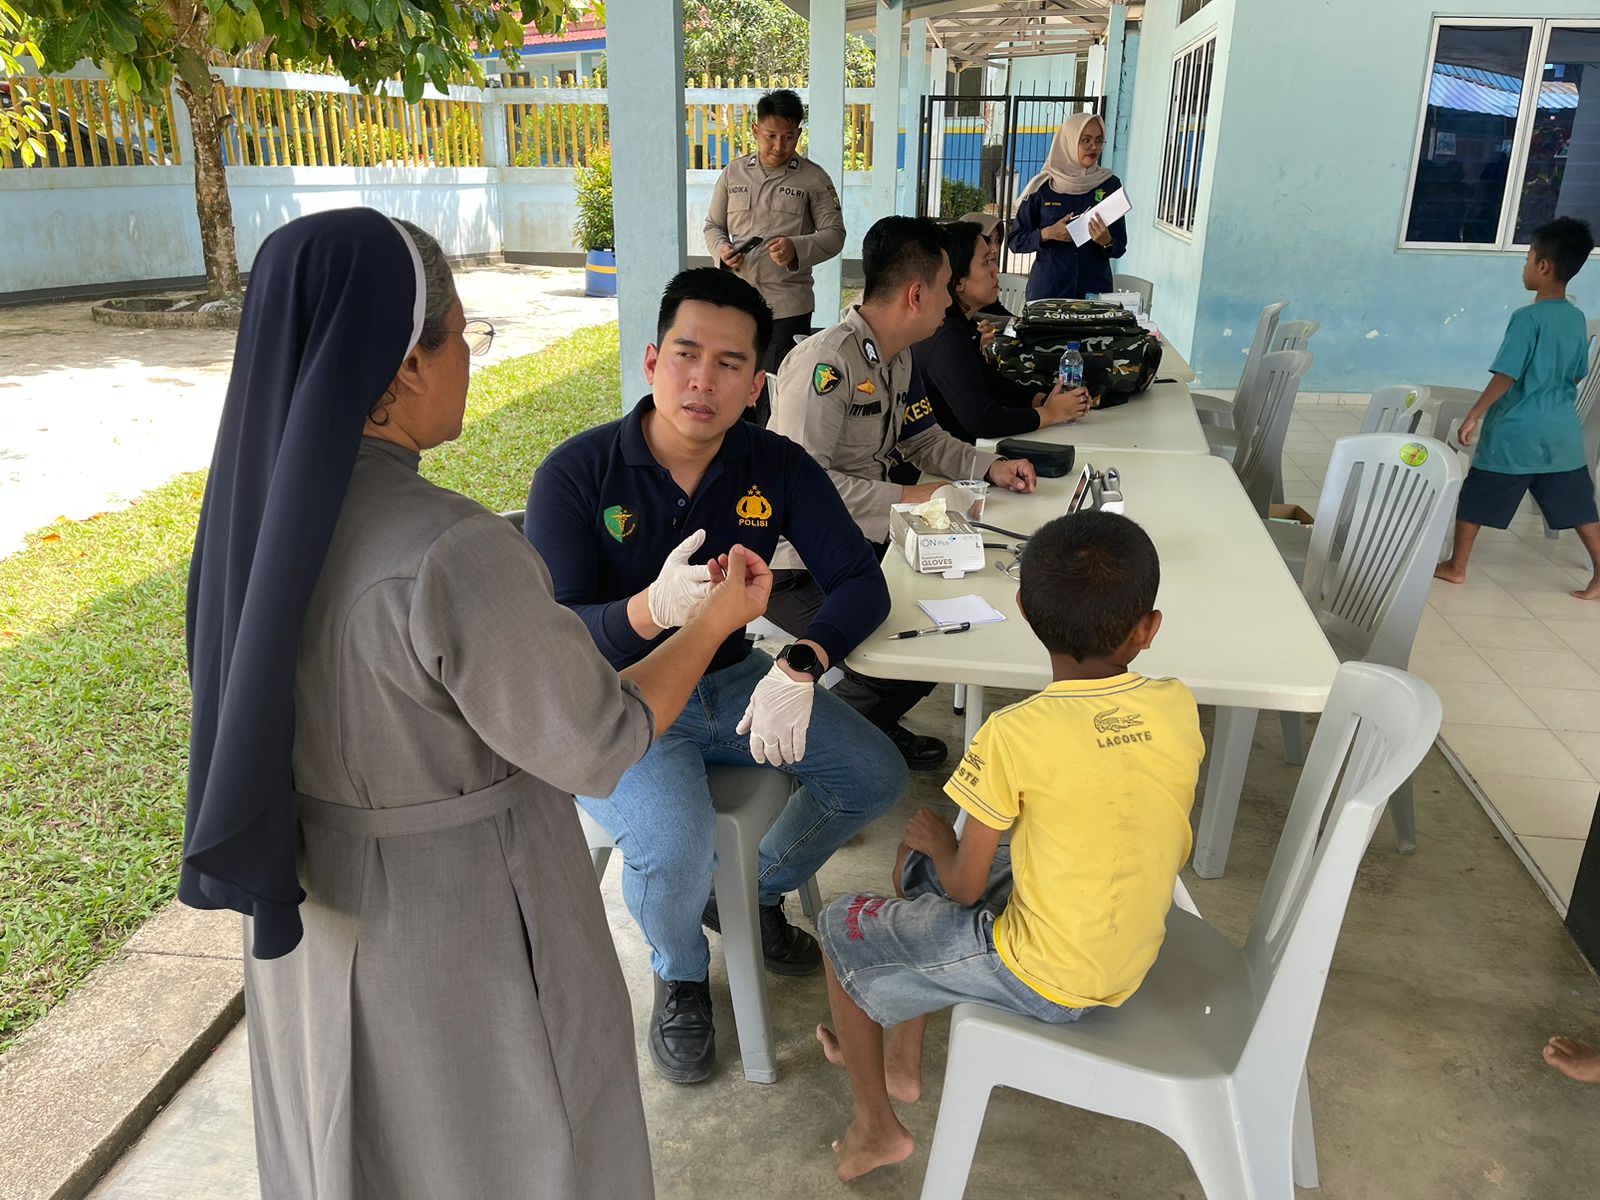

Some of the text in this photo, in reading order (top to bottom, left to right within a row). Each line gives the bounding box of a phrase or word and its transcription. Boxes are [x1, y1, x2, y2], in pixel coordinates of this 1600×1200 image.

[779, 187, 804, 198] POLRI
[739, 519, 768, 527] POLISI
[1097, 731, 1152, 748] LACOSTE
